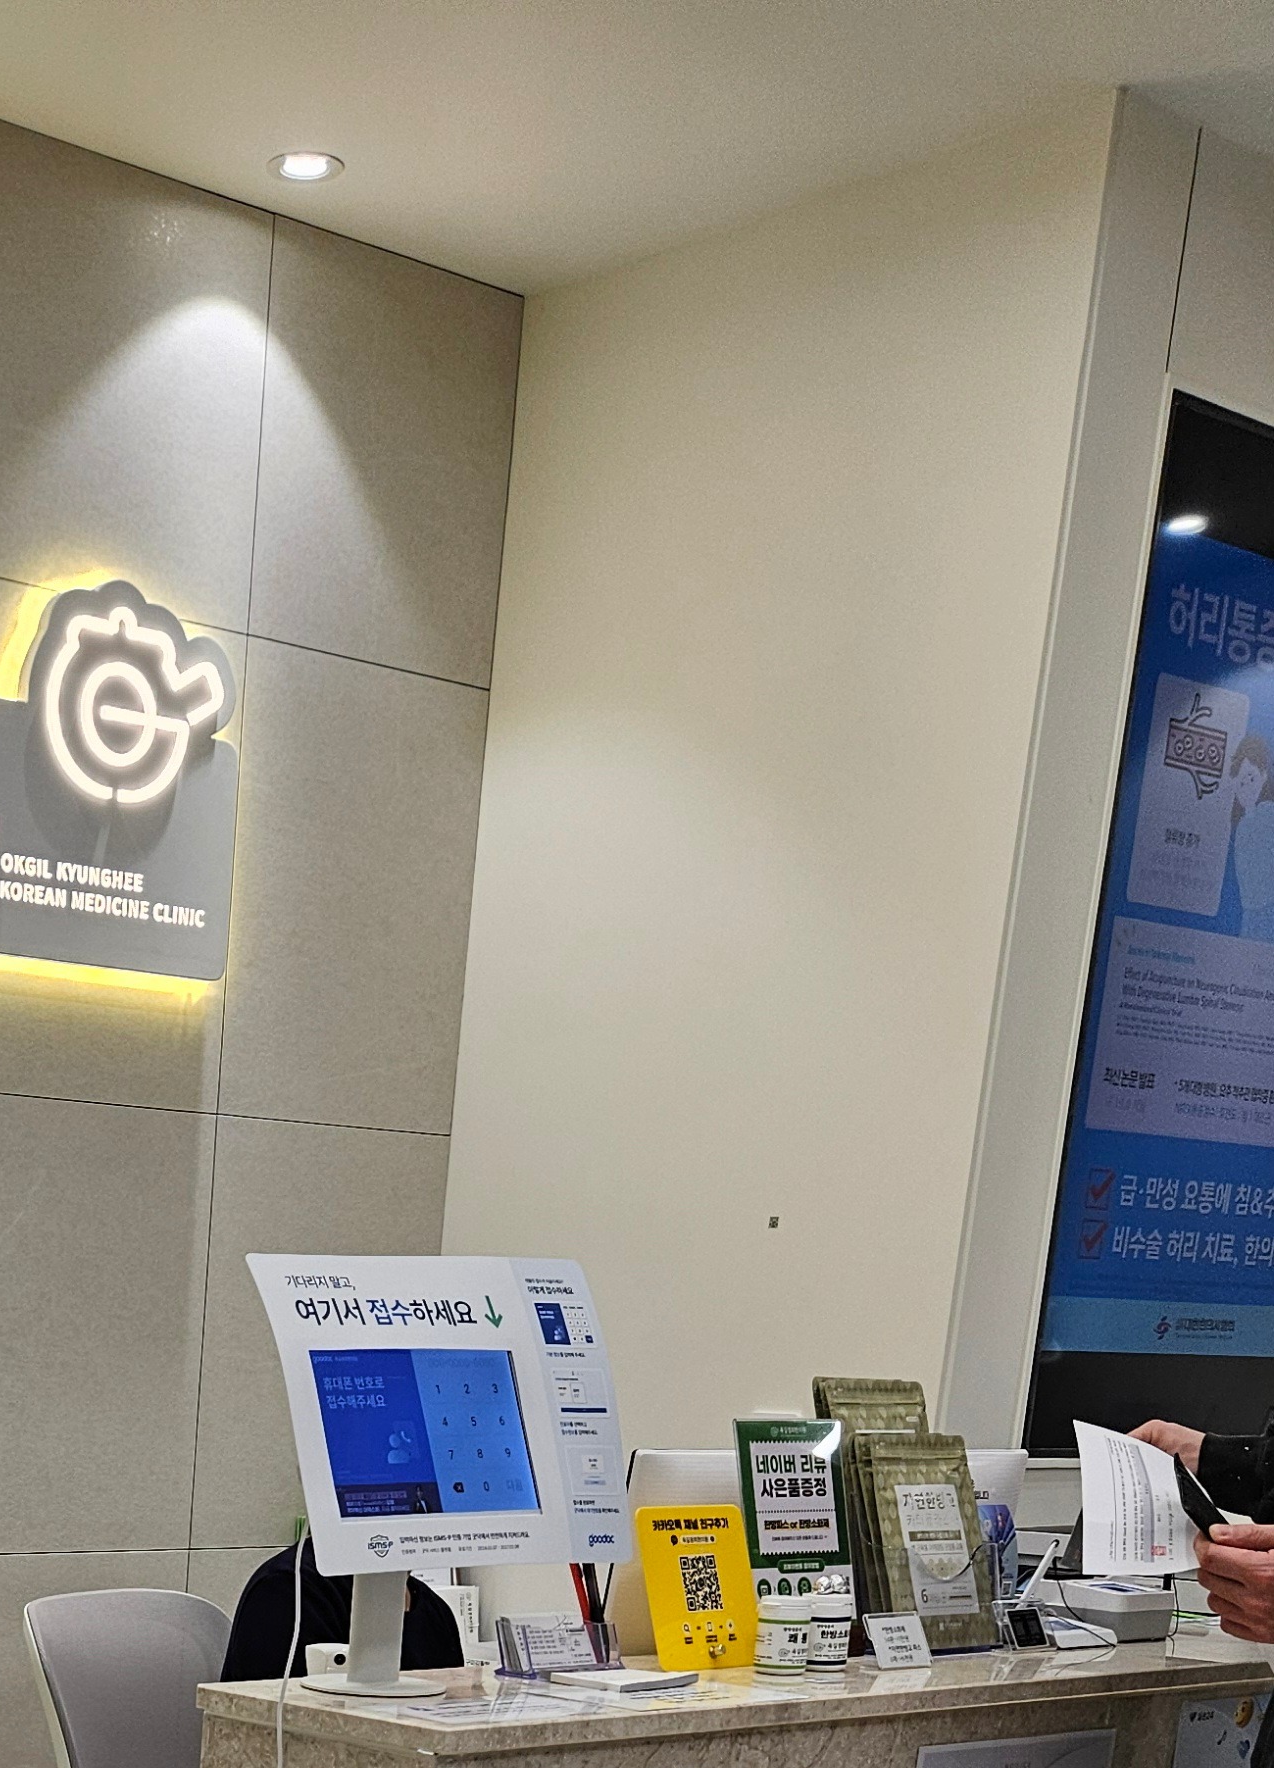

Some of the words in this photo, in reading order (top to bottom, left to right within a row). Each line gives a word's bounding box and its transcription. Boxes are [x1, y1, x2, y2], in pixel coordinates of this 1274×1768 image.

[0, 852, 53, 880] OKGIL
[56, 861, 144, 893] KYUNGHEE
[0, 880, 68, 909] KOREAN
[70, 890, 150, 920] MEDICINE
[152, 902, 206, 928] CLINIC
[1120, 1174, 1180, 1211] 급·만성
[1180, 1180, 1232, 1214] 요통에
[1112, 1226, 1163, 1260] 비수술
[1166, 1230, 1200, 1263] 허리
[1201, 1233, 1239, 1268] 치료,
[285, 1275, 328, 1288] 기다리지
[329, 1276, 356, 1290] 말고,
[295, 1297, 366, 1326] 여기서
[366, 1298, 477, 1327] 접수하세요
[323, 1376, 353, 1390] 휴대폰
[354, 1376, 385, 1390] 번호로
[435, 1385, 441, 1394] 1
[463, 1385, 471, 1394] 2
[491, 1384, 499, 1394] 3
[326, 1394, 387, 1409] 접수해주세요
[442, 1417, 448, 1427] 4
[471, 1416, 477, 1426] 5
[499, 1416, 506, 1426] 6
[448, 1450, 454, 1460] 7
[477, 1449, 484, 1458] 8
[505, 1448, 511, 1458] 9
[755, 1454, 796, 1474] 네이버
[800, 1454, 827, 1474] 리뷰
[483, 1482, 490, 1491] 0
[761, 1478, 827, 1498] 사은품증정
[588, 1534, 614, 1547] goodoc
